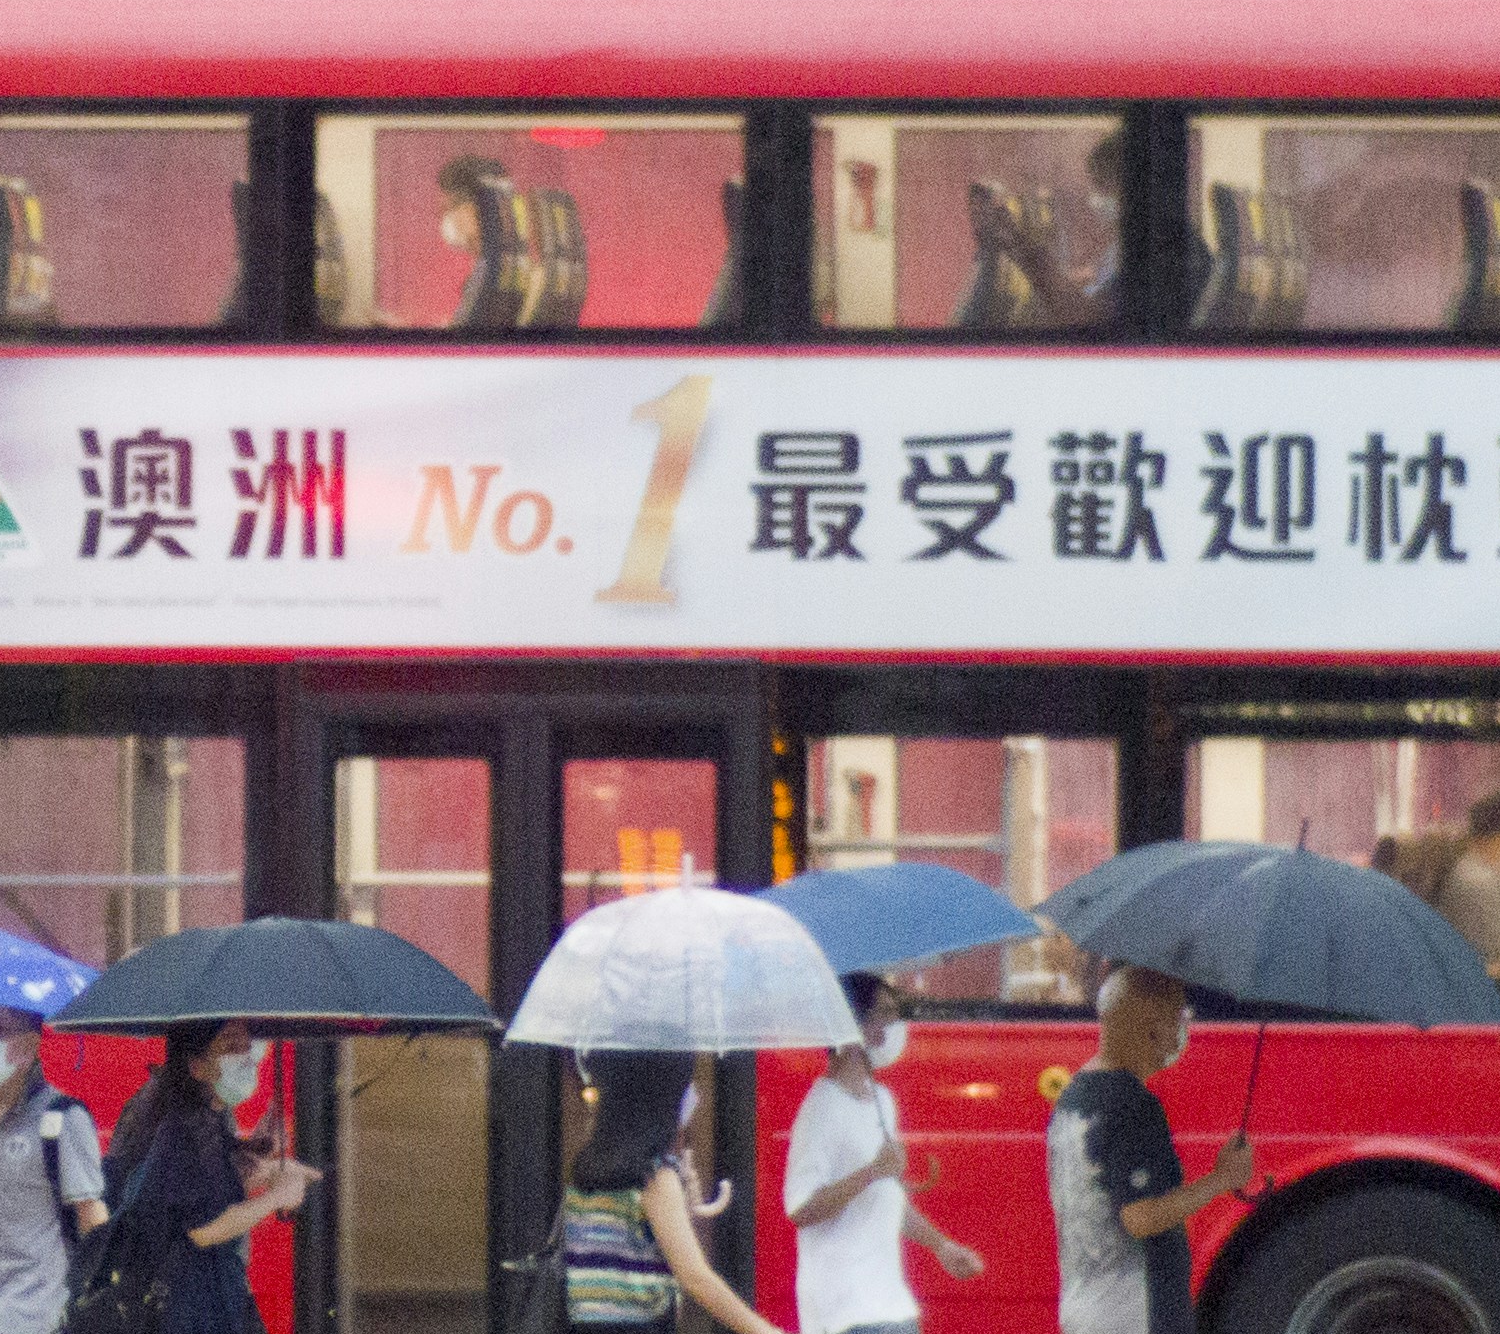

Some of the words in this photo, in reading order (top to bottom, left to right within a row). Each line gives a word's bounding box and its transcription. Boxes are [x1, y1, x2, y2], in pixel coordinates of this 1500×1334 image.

[78, 427, 348, 560] 澳洲
[401, 464, 575, 555] No.
[594, 374, 714, 607] 1
